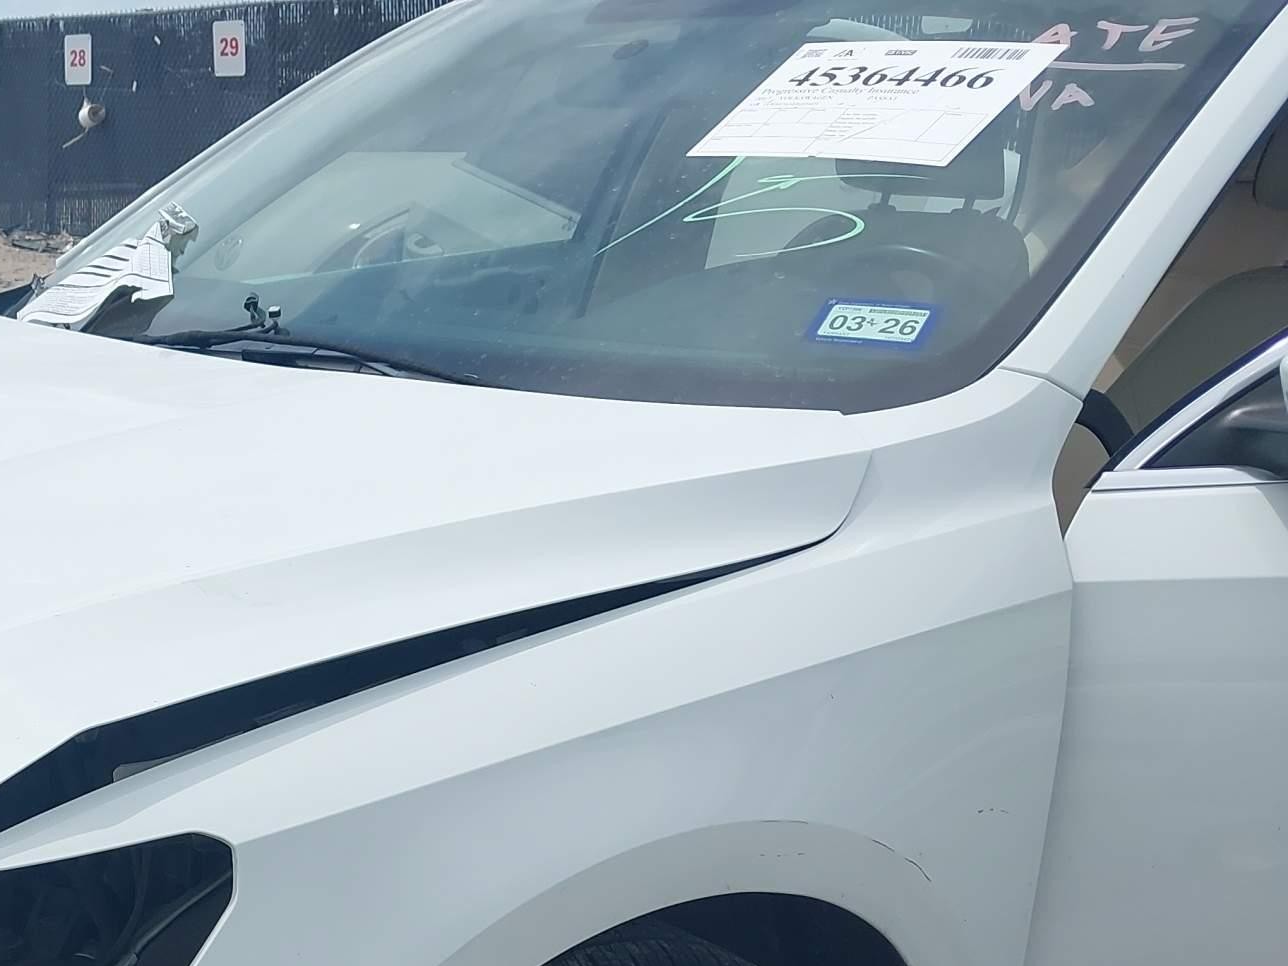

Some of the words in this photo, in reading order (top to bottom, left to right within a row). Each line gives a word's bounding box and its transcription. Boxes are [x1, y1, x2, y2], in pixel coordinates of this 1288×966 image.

[220, 38, 239, 57] 29
[70, 50, 86, 67] 28
[788, 65, 1006, 89] 45364466
[828, 314, 867, 332] 03
[878, 318, 920, 336] 26
